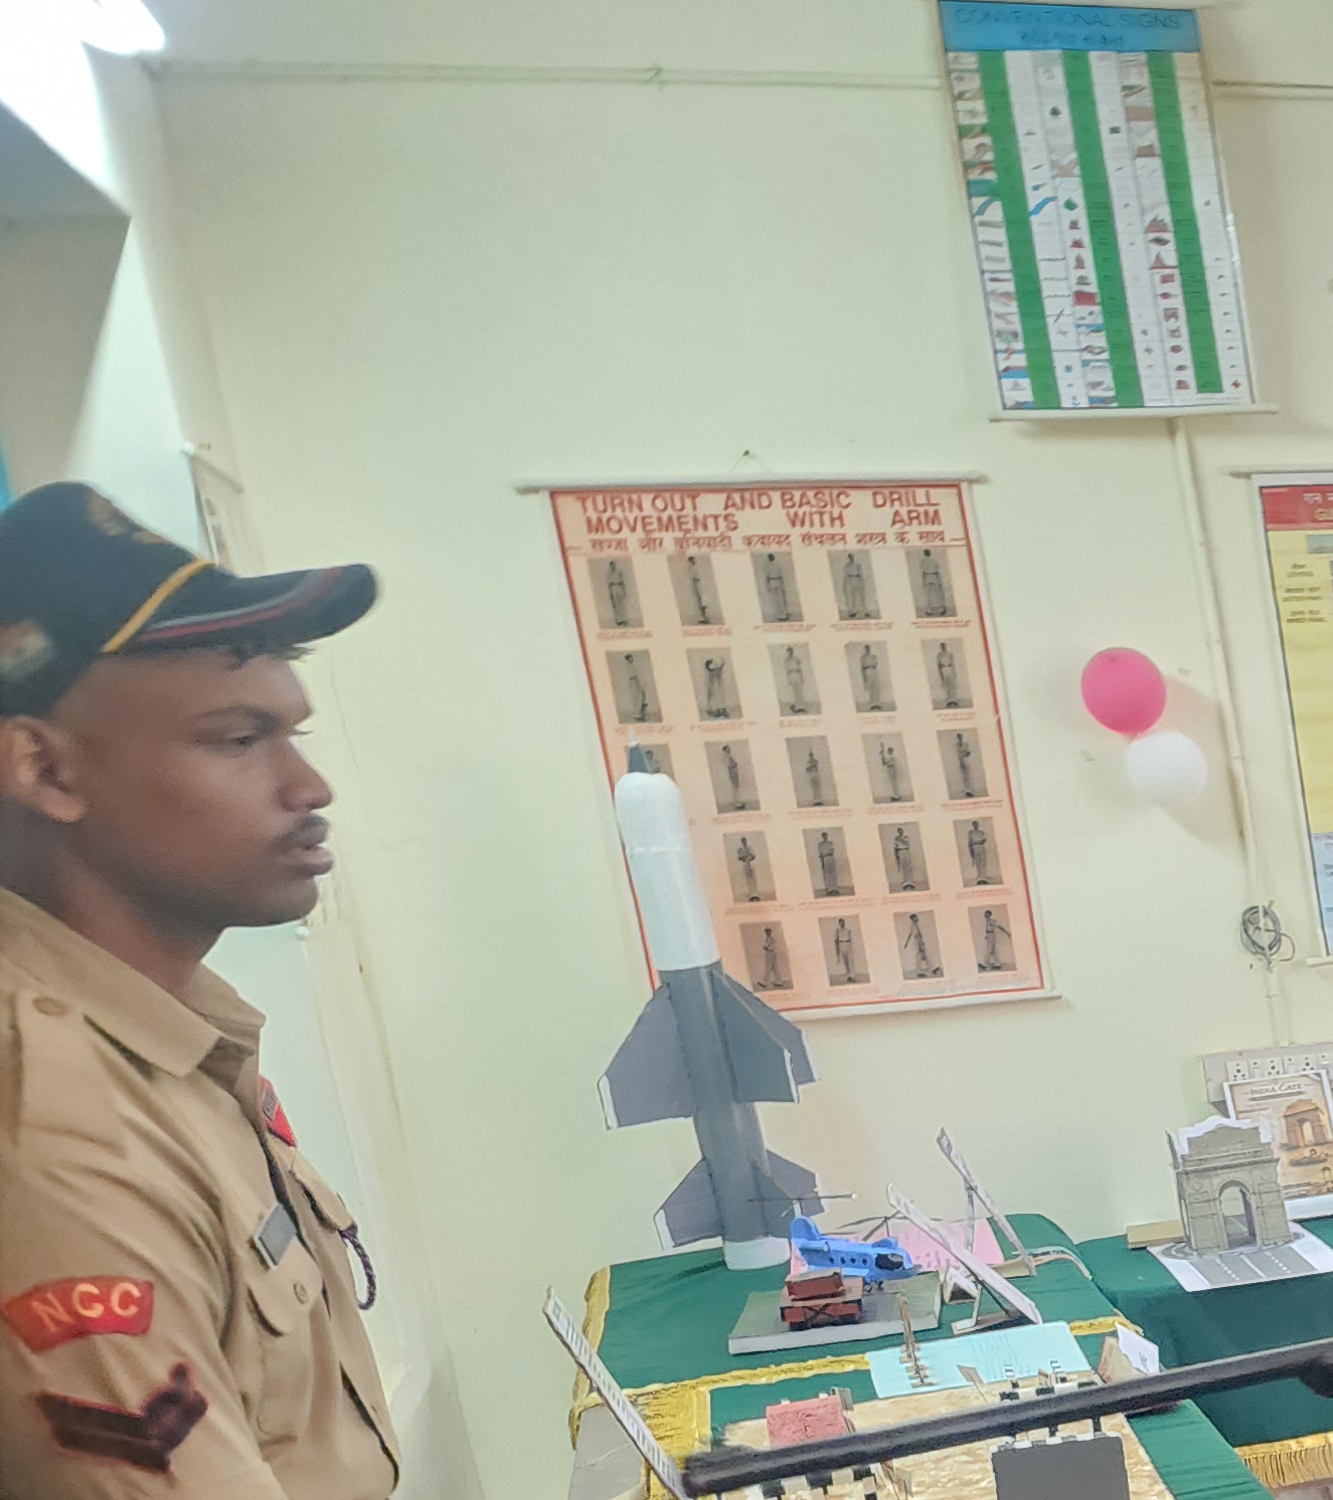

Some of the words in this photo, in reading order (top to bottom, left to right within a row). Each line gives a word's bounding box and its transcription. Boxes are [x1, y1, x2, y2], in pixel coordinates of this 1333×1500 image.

[1119, 12, 1182, 29] SIGNS
[580, 494, 644, 514] TURN
[651, 493, 702, 513] OUT
[723, 491, 773, 512] AND
[780, 490, 852, 510] BASIC
[871, 488, 941, 508] DRILL
[586, 512, 739, 534] MOVEMENTS
[786, 510, 846, 528] WITH
[891, 508, 942, 527] ARM
[1249, 1086, 1277, 1096] INDIA
[1278, 1083, 1302, 1091] GATE
[32, 1283, 143, 1333] NCC
